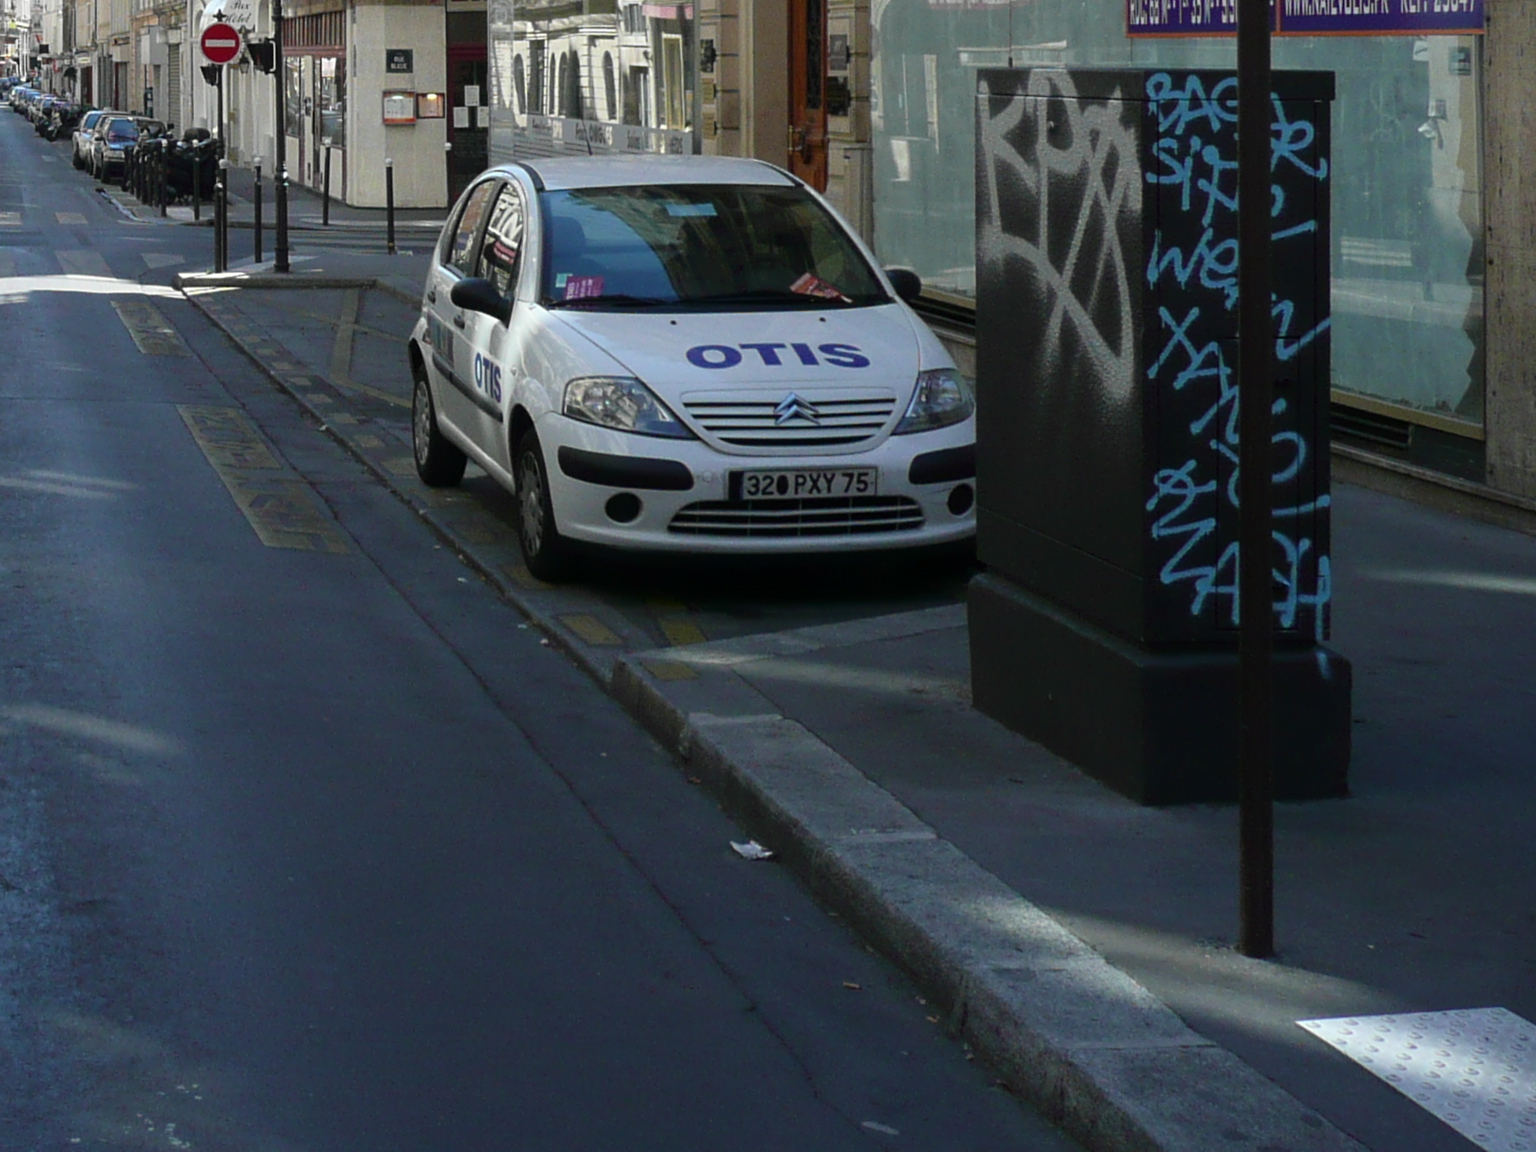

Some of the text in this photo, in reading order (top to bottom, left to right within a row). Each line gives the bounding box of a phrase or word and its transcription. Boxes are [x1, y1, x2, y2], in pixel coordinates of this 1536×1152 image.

[686, 342, 870, 369] OTIS
[475, 352, 501, 403] OTIS
[794, 473, 836, 495] PXY
[841, 472, 869, 492] 75
